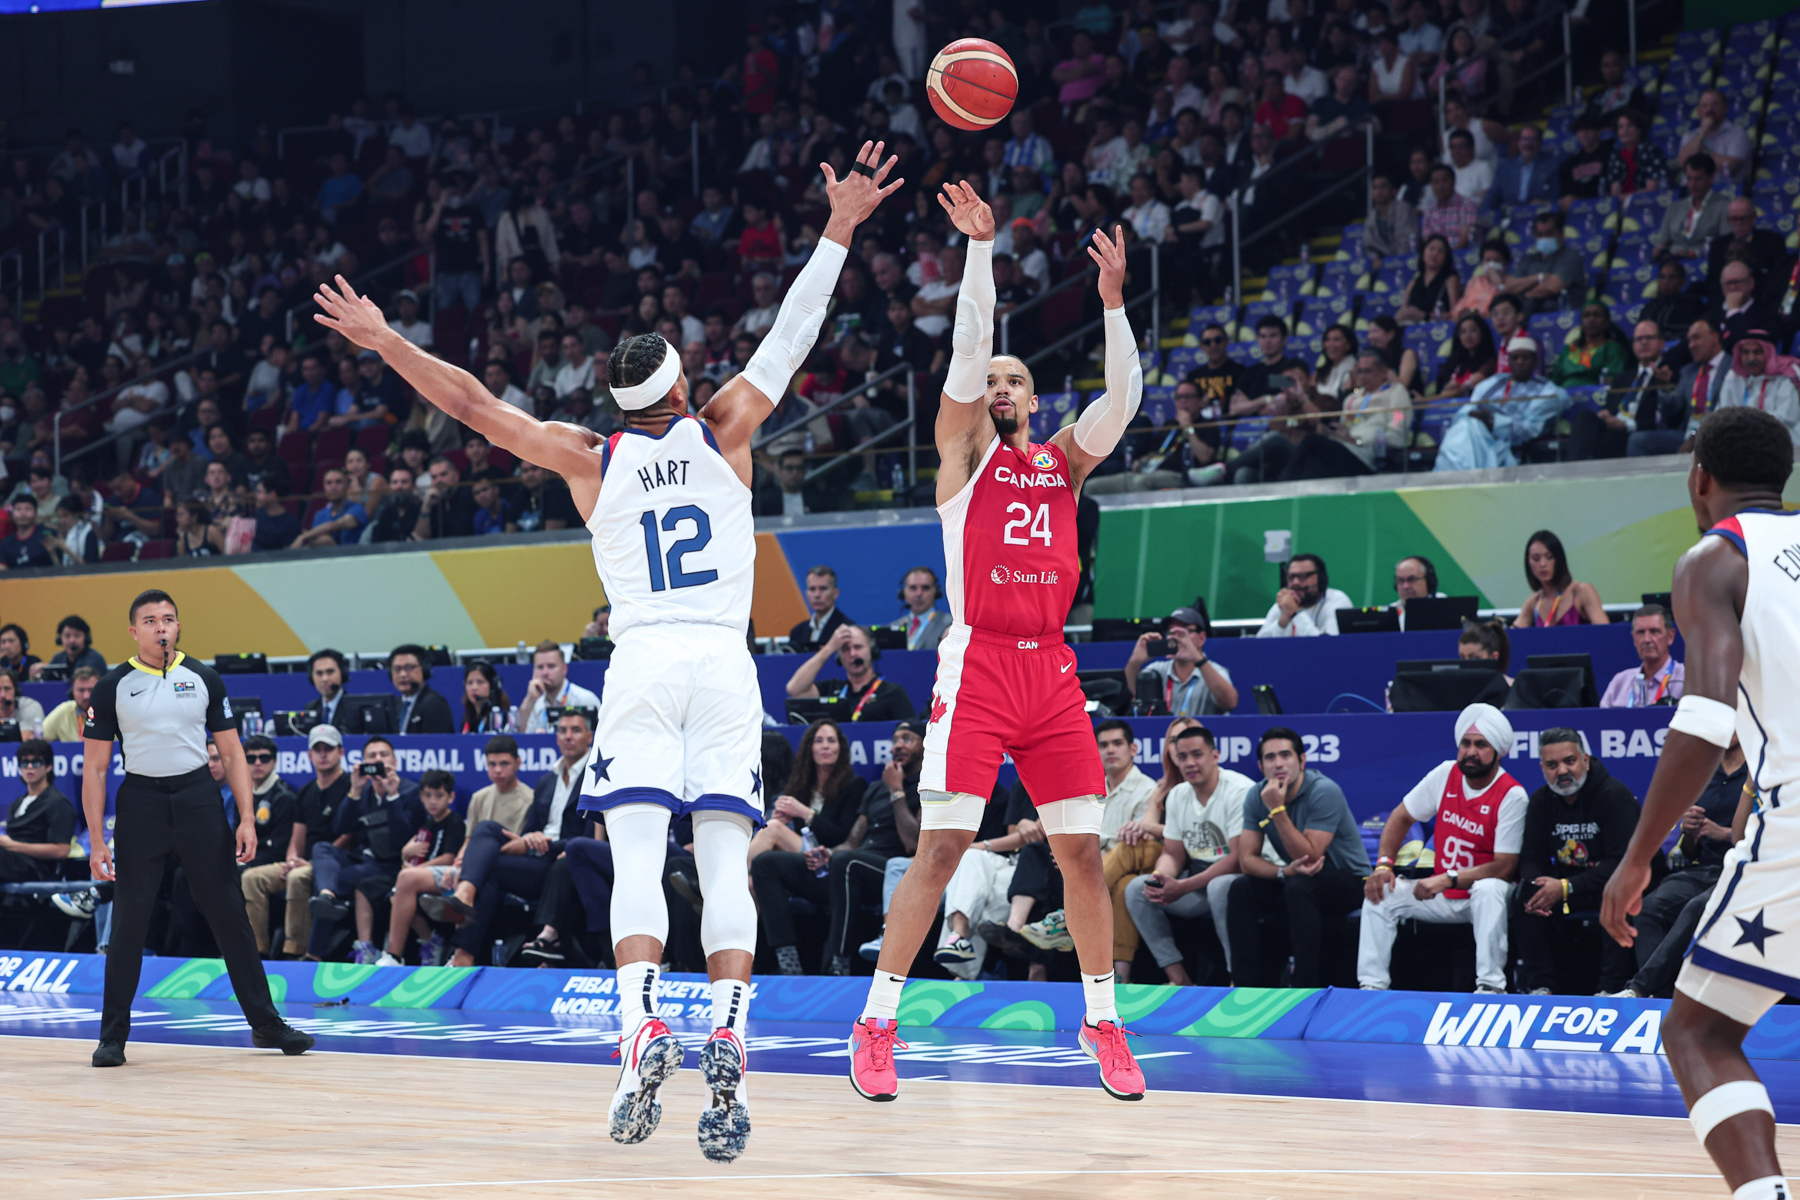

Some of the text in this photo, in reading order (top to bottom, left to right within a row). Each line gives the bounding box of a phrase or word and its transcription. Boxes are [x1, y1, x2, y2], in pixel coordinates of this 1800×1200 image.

[637, 460, 690, 492] HART
[994, 466, 1067, 489] CANADA
[1003, 501, 1053, 547] 24
[639, 504, 719, 593] 12
[1012, 570, 1059, 584] Sun Life
[1017, 641, 1038, 649] CAN
[277, 751, 312, 773] IBA
[473, 747, 558, 772] WRLD
[1213, 736, 1252, 763] UP
[1442, 810, 1485, 837] CANADA
[1441, 836, 1475, 871] 95
[7, 958, 79, 993] ALL
[563, 976, 615, 995] FIBA
[1423, 1002, 1542, 1048] WIN
[1540, 1006, 1618, 1036] FOR
